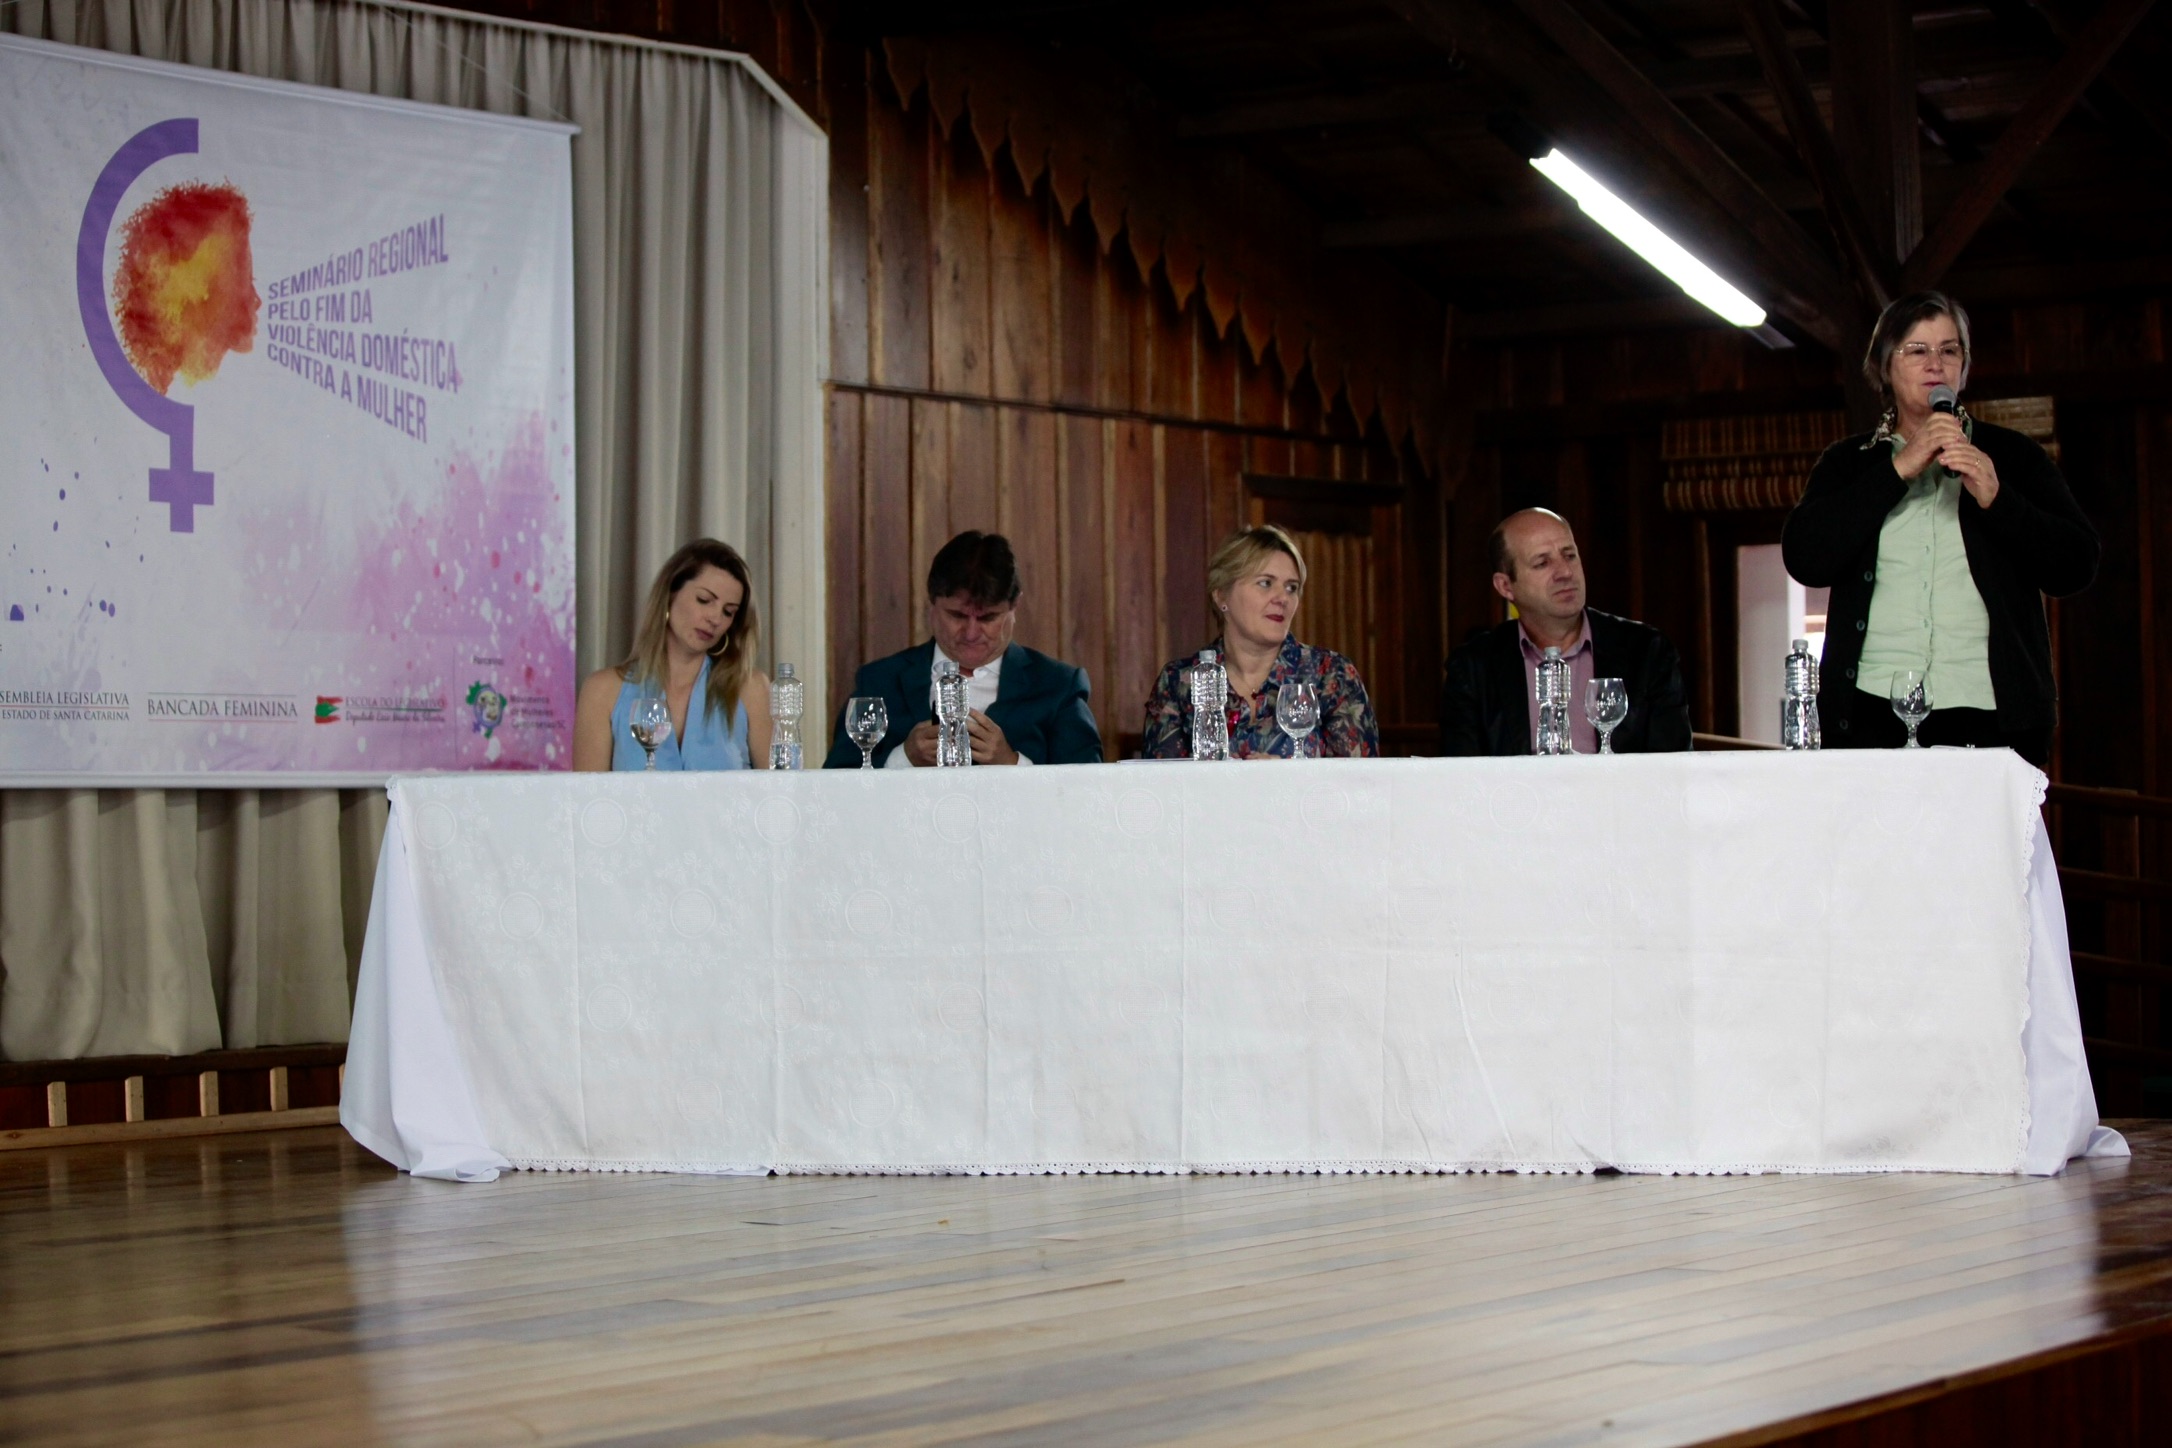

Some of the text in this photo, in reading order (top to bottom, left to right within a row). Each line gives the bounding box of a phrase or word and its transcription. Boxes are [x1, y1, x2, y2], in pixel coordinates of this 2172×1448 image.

[268, 213, 449, 300] SEMINÁRIO REGIONAL
[268, 288, 373, 324] PELO FIM DA
[267, 323, 458, 394] VIOLÊNCIA DOMÉSTICA
[267, 343, 428, 444] CONTRA A MULHER
[2, 709, 130, 722] ESTADO DE SANTA CATARINA
[57, 691, 130, 705] LEGISLATIVA
[147, 698, 299, 718] BANCADA FEMININA
